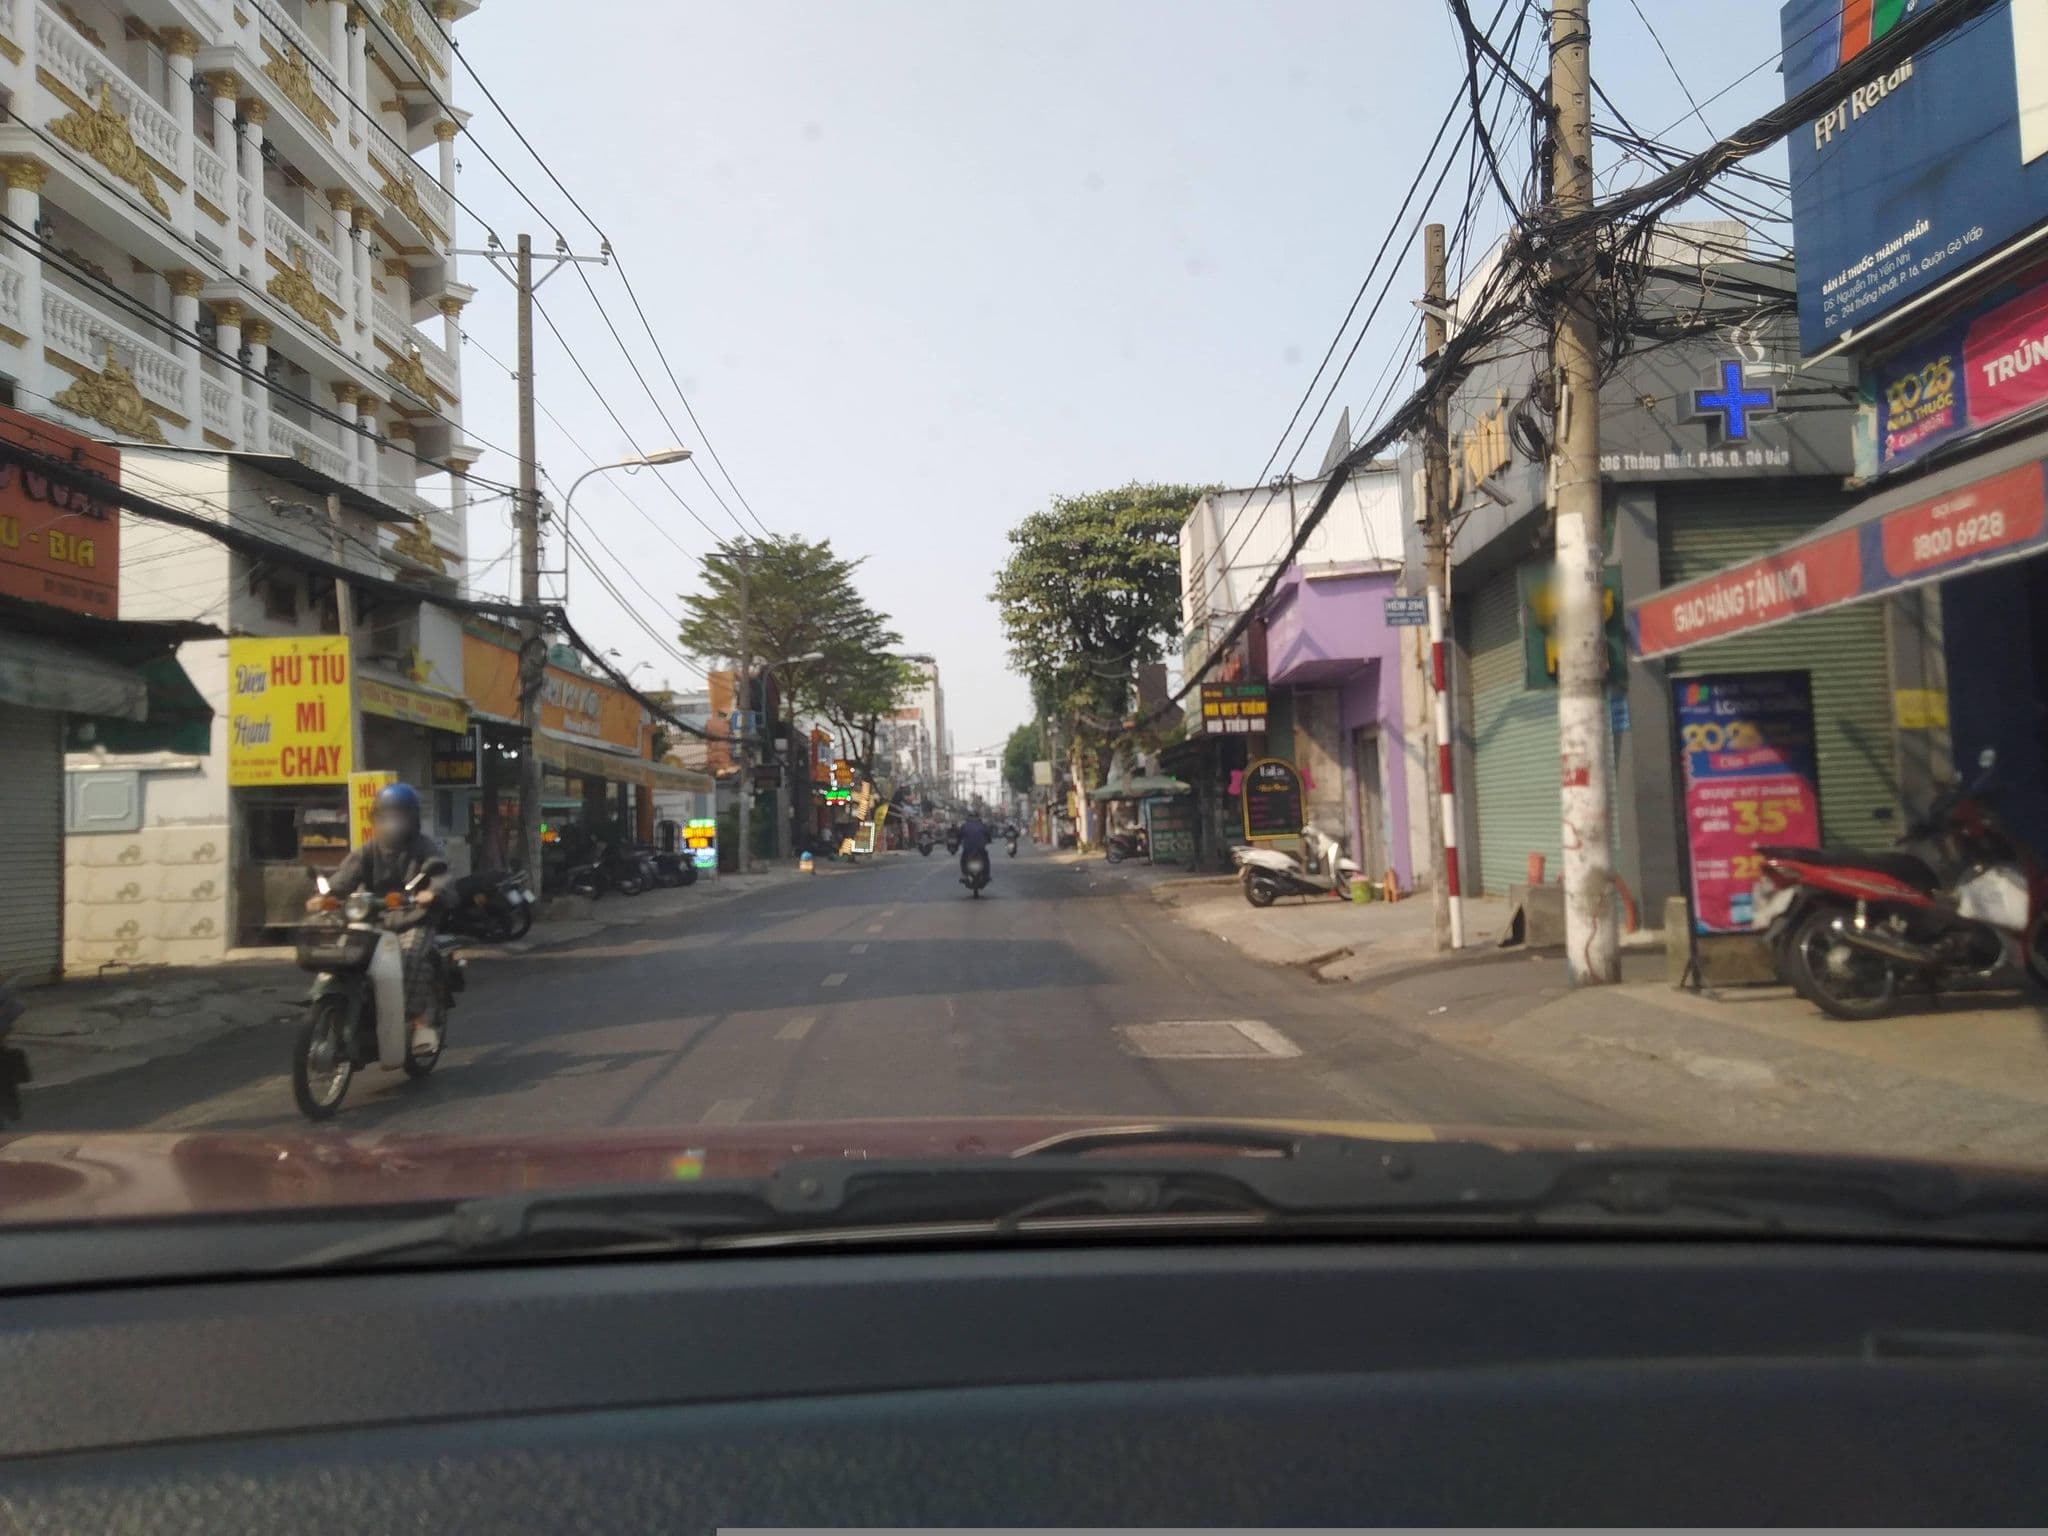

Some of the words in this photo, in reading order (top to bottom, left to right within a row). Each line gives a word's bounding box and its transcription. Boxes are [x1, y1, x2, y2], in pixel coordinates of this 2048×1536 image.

[1815, 99, 1848, 151] FPT
[1852, 57, 1913, 120] Retail
[1848, 256, 1874, 280] THUỐC
[1875, 239, 1902, 263] THÀNH
[1904, 219, 1930, 245] PHẨM
[1854, 288, 1878, 307] Thống
[1921, 249, 1946, 271] Quận
[1947, 238, 1962, 255] Gò
[1962, 224, 1984, 246] Vấp
[1837, 280, 1866, 303] Nguyễn
[1867, 270, 1879, 286] Thị
[1896, 250, 1911, 268] Nhi
[1914, 393, 1954, 420] THUỐC
[49, 529, 95, 568] BIA
[1913, 527, 1952, 561] 1800
[1955, 510, 2003, 548] 6928
[1672, 597, 1705, 633] GIAO
[1705, 584, 1745, 624] HÀNG
[1745, 569, 1777, 618] TẬN
[271, 644, 301, 686] HỦ
[308, 647, 345, 685] TÍU
[295, 694, 326, 733] MÌ
[281, 745, 342, 777] CHAY
